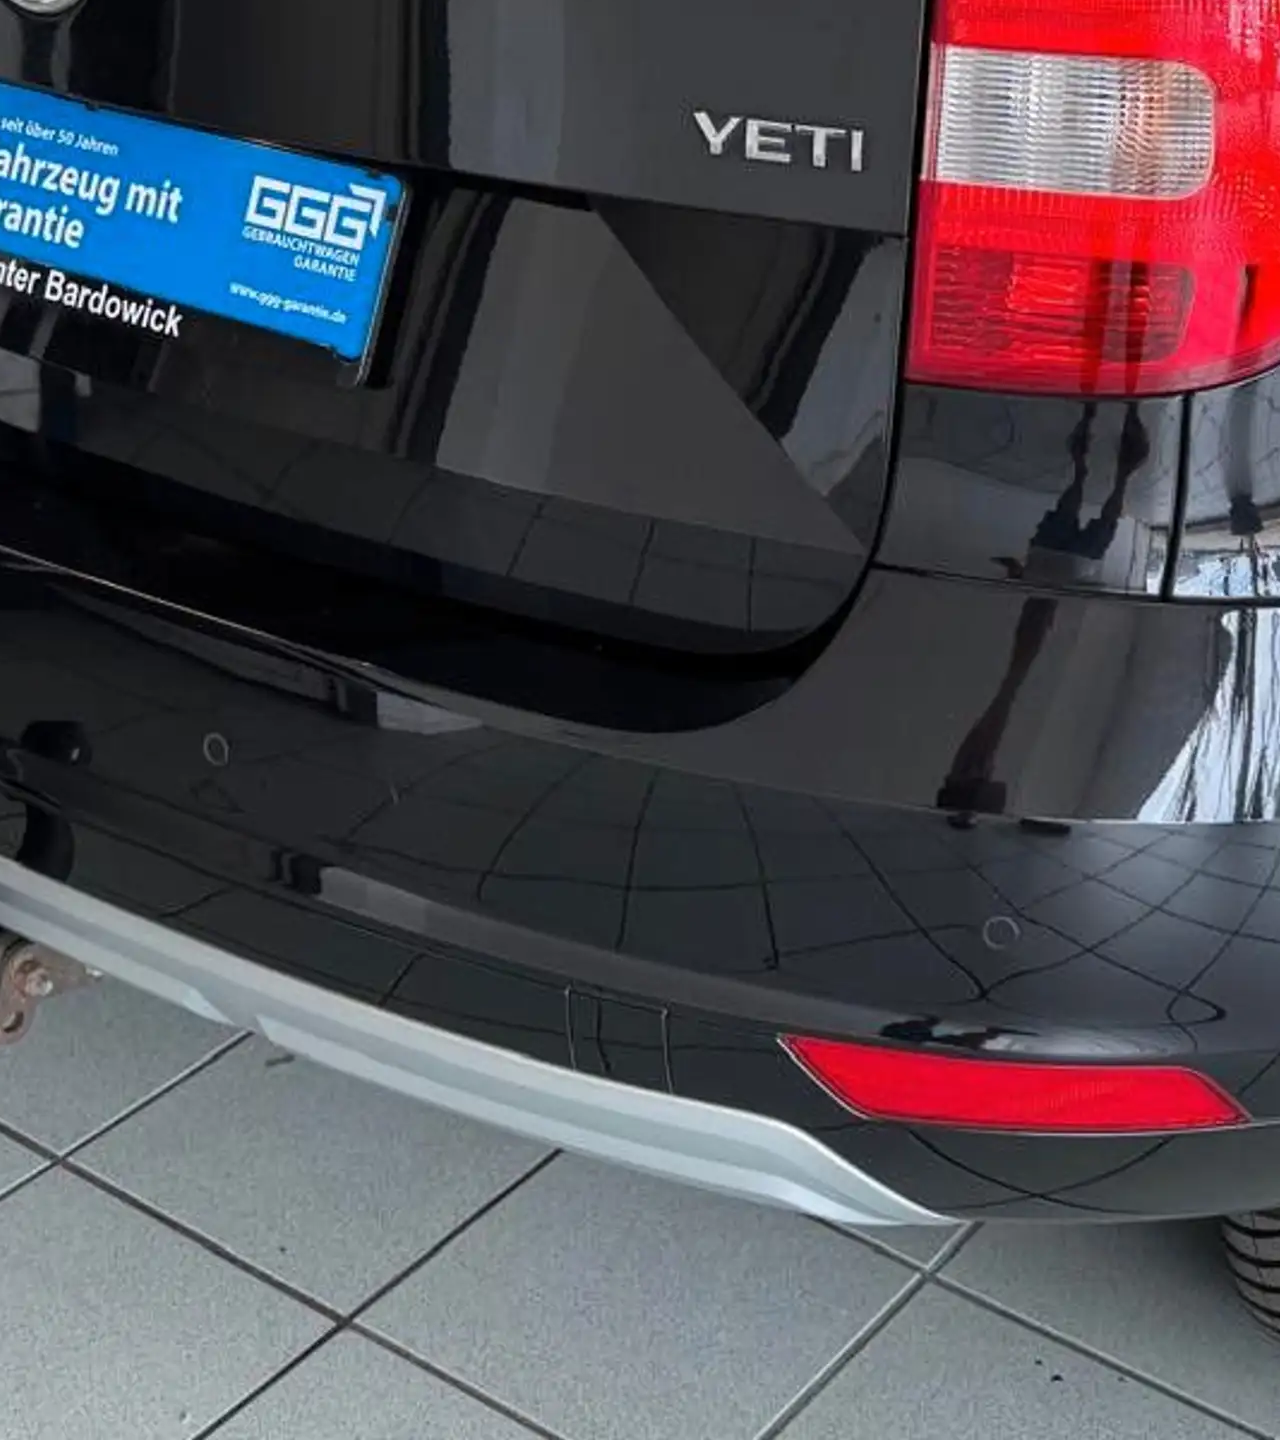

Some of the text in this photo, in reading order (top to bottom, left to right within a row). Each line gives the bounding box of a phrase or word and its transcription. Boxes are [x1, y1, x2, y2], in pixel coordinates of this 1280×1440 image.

[0, 117, 24, 134] seit
[57, 128, 75, 146] 50
[74, 133, 120, 157] Jahren
[693, 111, 864, 172] YETI
[125, 178, 184, 224] mit
[244, 175, 376, 251] GGG
[241, 226, 361, 267] GEBRAUCHTWAGEN
[294, 255, 357, 282] GARANTIE
[44, 268, 185, 338] Bardowick
[228, 281, 348, 325] www.ggg-garantie.de
